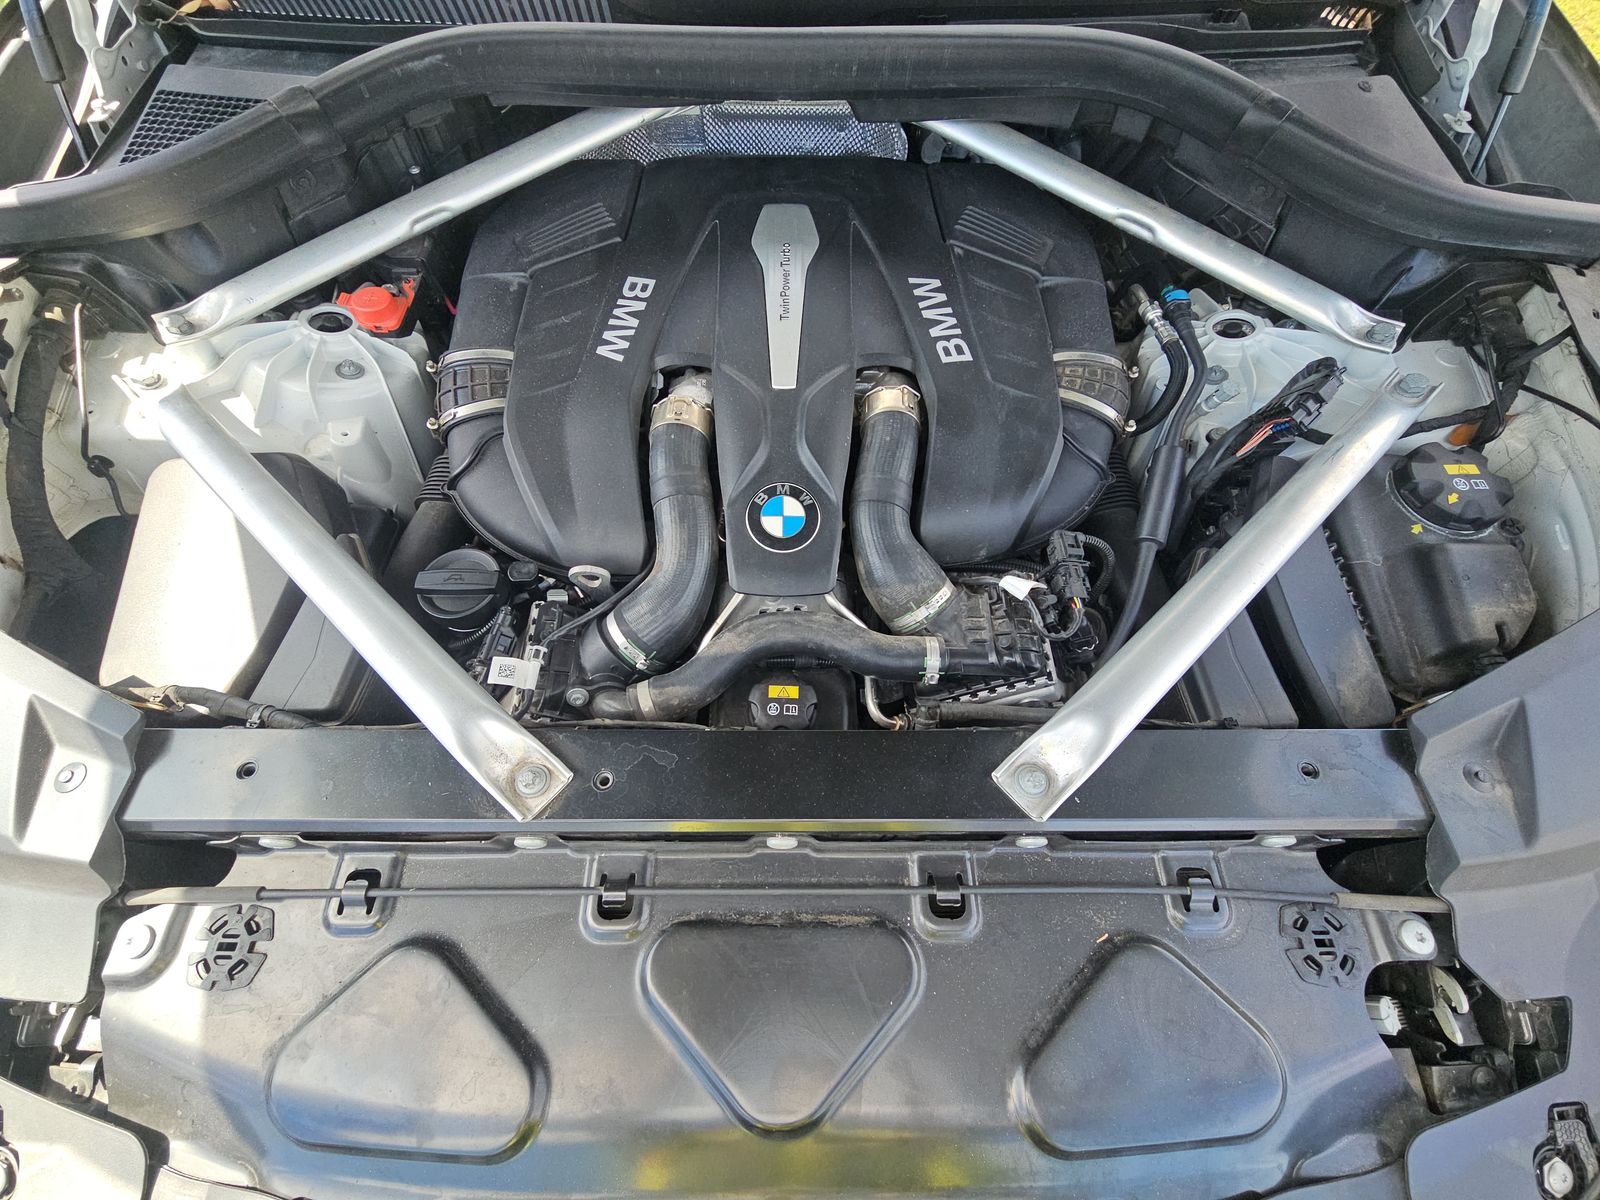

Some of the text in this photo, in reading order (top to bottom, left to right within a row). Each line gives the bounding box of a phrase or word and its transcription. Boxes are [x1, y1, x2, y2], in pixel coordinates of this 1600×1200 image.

[596, 276, 656, 362] BMW
[780, 242, 791, 321] TwinPower Turbo
[907, 277, 973, 363] BMW
[754, 484, 813, 506] BMW
